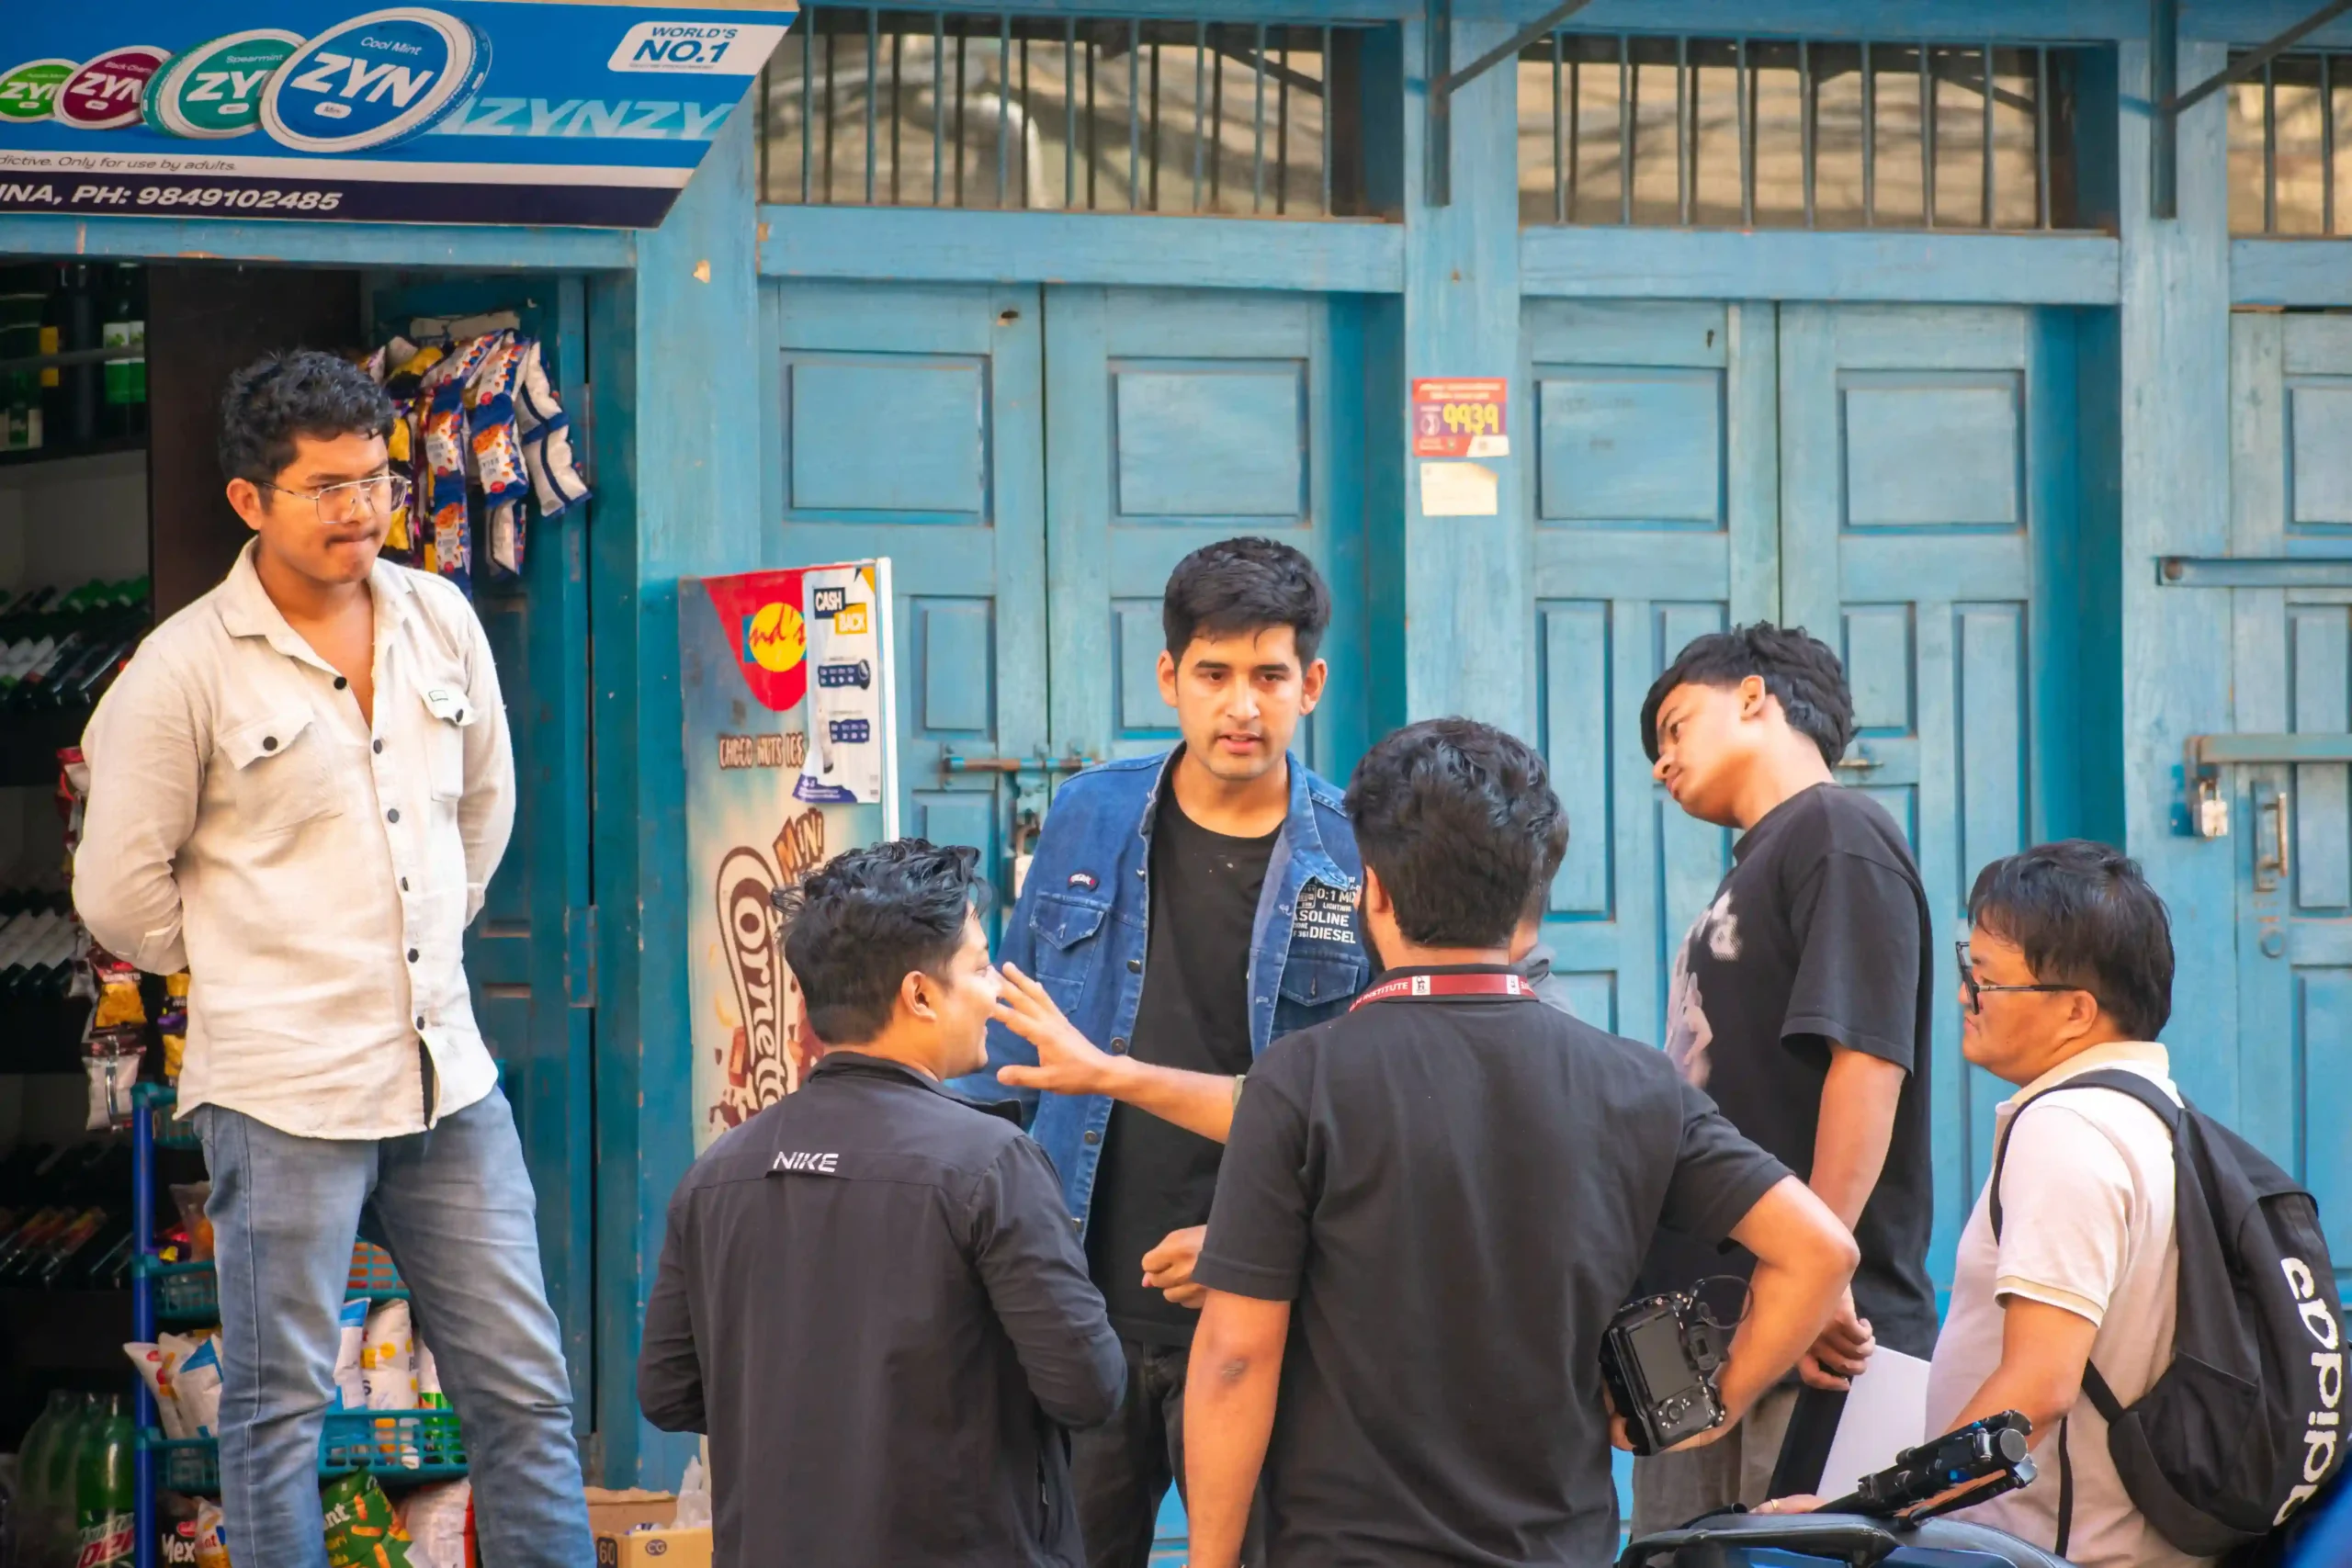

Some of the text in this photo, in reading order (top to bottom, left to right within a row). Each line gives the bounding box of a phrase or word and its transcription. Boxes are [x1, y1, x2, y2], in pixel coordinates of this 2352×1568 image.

[651, 27, 738, 39] WORLD'S
[361, 37, 423, 55] Cool Mint
[633, 39, 730, 62] NO.1
[226, 54, 283, 63] Spearmint
[290, 52, 434, 107] ZYN
[58, 156, 94, 169] Only
[99, 157, 125, 168] for
[127, 160, 156, 169] use
[161, 159, 179, 171] by
[72, 186, 131, 205] PH:
[137, 186, 343, 210] 9849102485
[816, 591, 842, 611] CASH
[839, 613, 865, 631] BACK
[719, 737, 753, 769] CHOCO
[757, 736, 783, 767] NUTS
[1310, 926, 1356, 943] DIESEL
[1363, 981, 1408, 1000] INSTITUTE
[773, 1151, 839, 1172] NIKE
[2273, 1257, 2342, 1527] adidas
